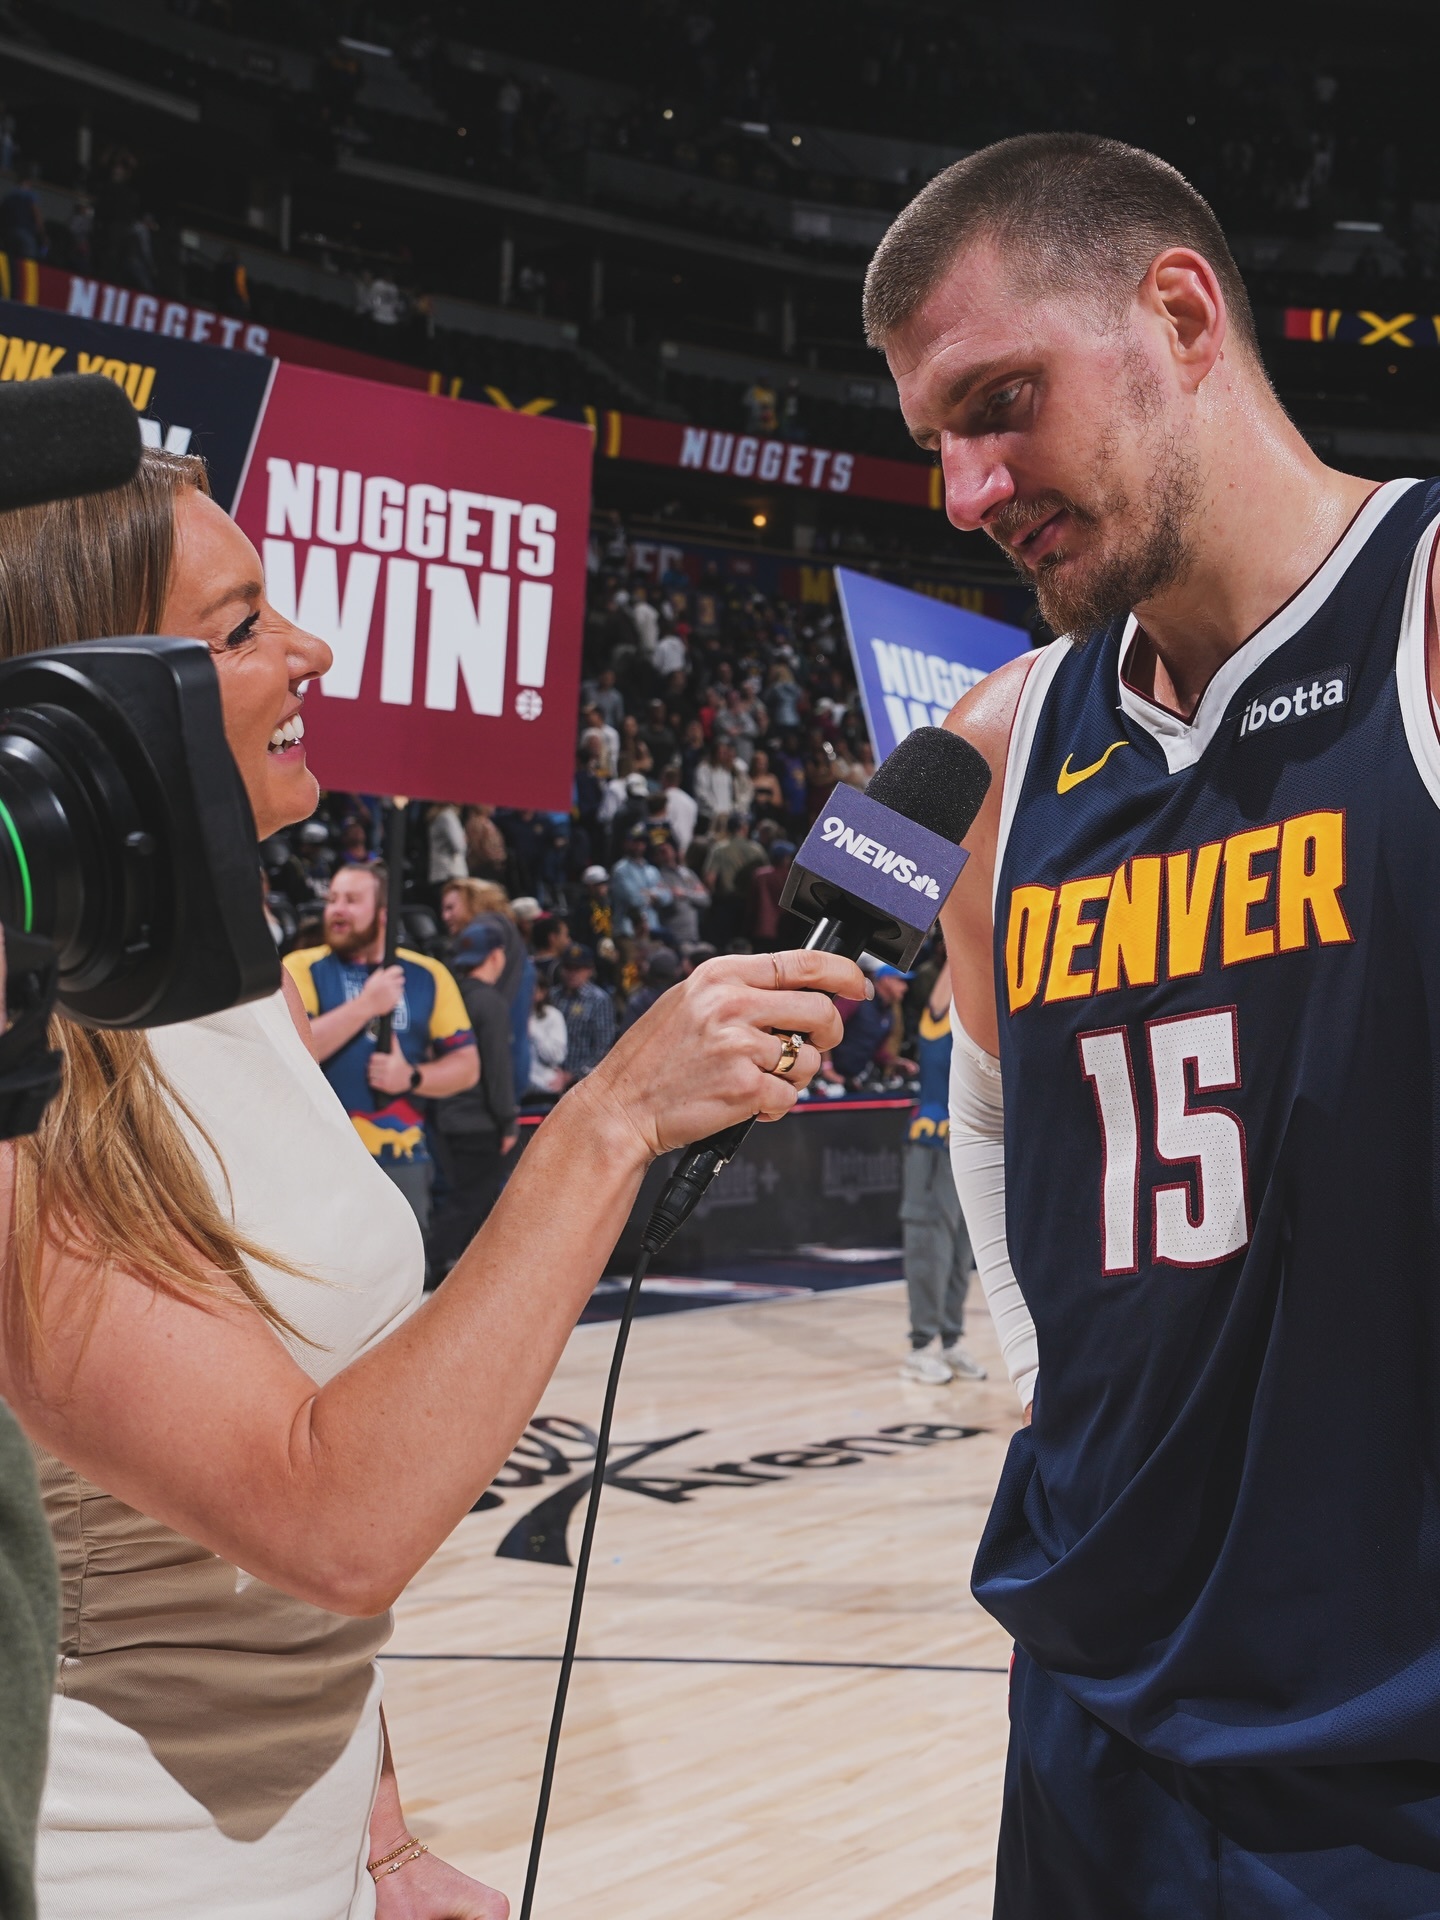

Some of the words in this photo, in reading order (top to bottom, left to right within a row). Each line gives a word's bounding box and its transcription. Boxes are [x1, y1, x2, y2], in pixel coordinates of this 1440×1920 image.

[67, 275, 269, 355] NUGGETS
[679, 426, 855, 492] NUGGETS
[266, 456, 557, 577] NUGGETS
[262, 537, 553, 721] WIN!
[1240, 679, 1344, 738] ibotta
[820, 816, 918, 884] 9NEWS
[1004, 808, 1356, 1016] DENVER
[1076, 1004, 1253, 1276] 15
[604, 1423, 992, 1504] Arena
